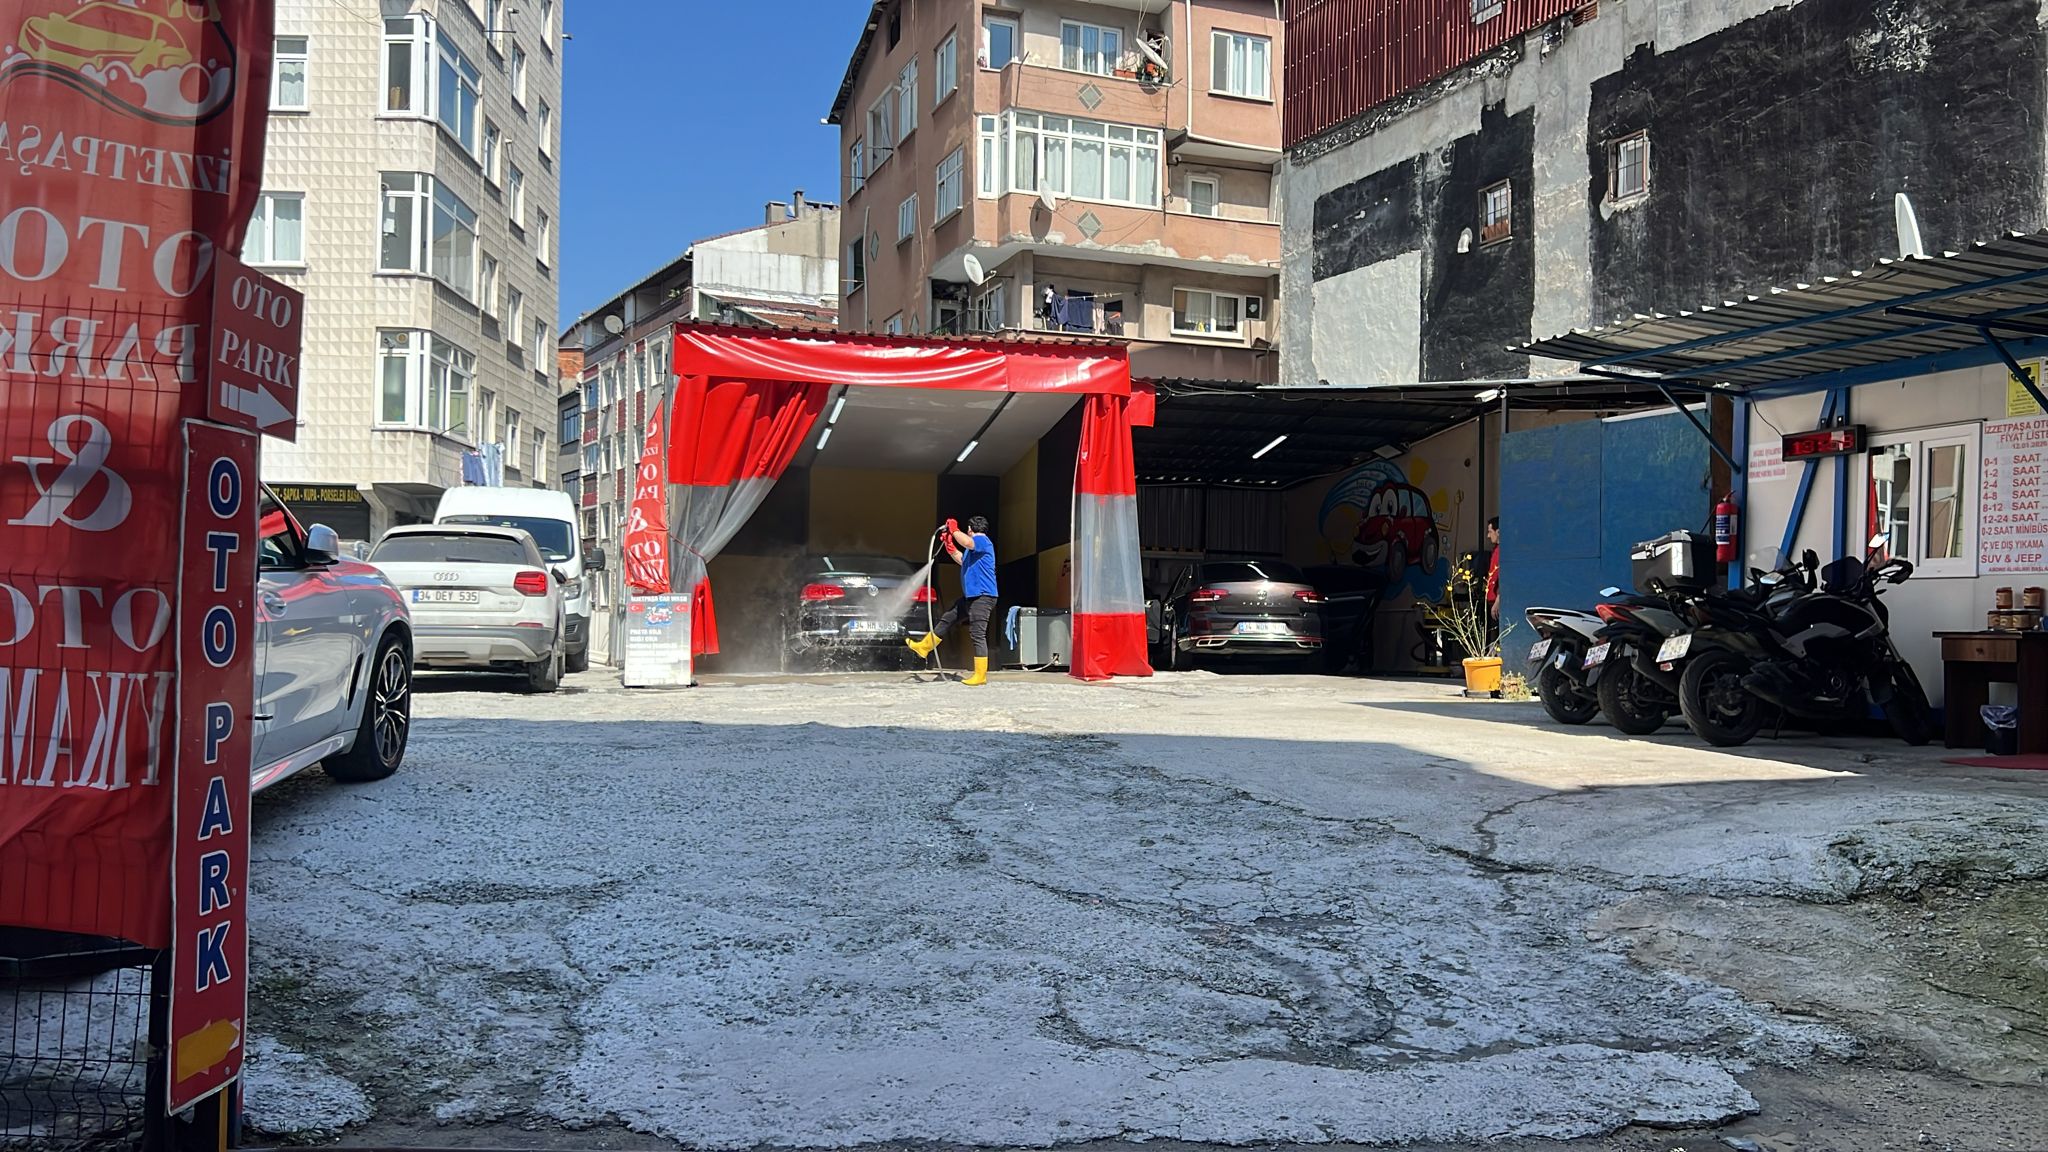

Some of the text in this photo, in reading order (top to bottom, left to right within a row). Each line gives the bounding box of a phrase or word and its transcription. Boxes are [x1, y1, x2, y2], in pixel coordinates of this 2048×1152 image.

[232, 275, 292, 328] OTO
[218, 328, 296, 389] PARK
[1984, 453, 2041, 466] 0-1 SAAT
[1984, 465, 2041, 478] 1-2 SAAT
[1983, 477, 2041, 489] 2-4 SAAT
[2012, 489, 2040, 499] SAAT
[1982, 501, 2040, 512] 8-12 SAAT
[1982, 513, 2040, 524] 12-24 SAAT
[1981, 527, 1993, 536] 0-2
[1994, 526, 2014, 535] SAAT
[1990, 541, 2000, 550] VE
[2014, 539, 2045, 549] YIKAMA
[1981, 554, 2042, 564] SUV & JEEP
[420, 591, 478, 601] 34 DEY 535
[196, 456, 242, 993] OTO PARK
